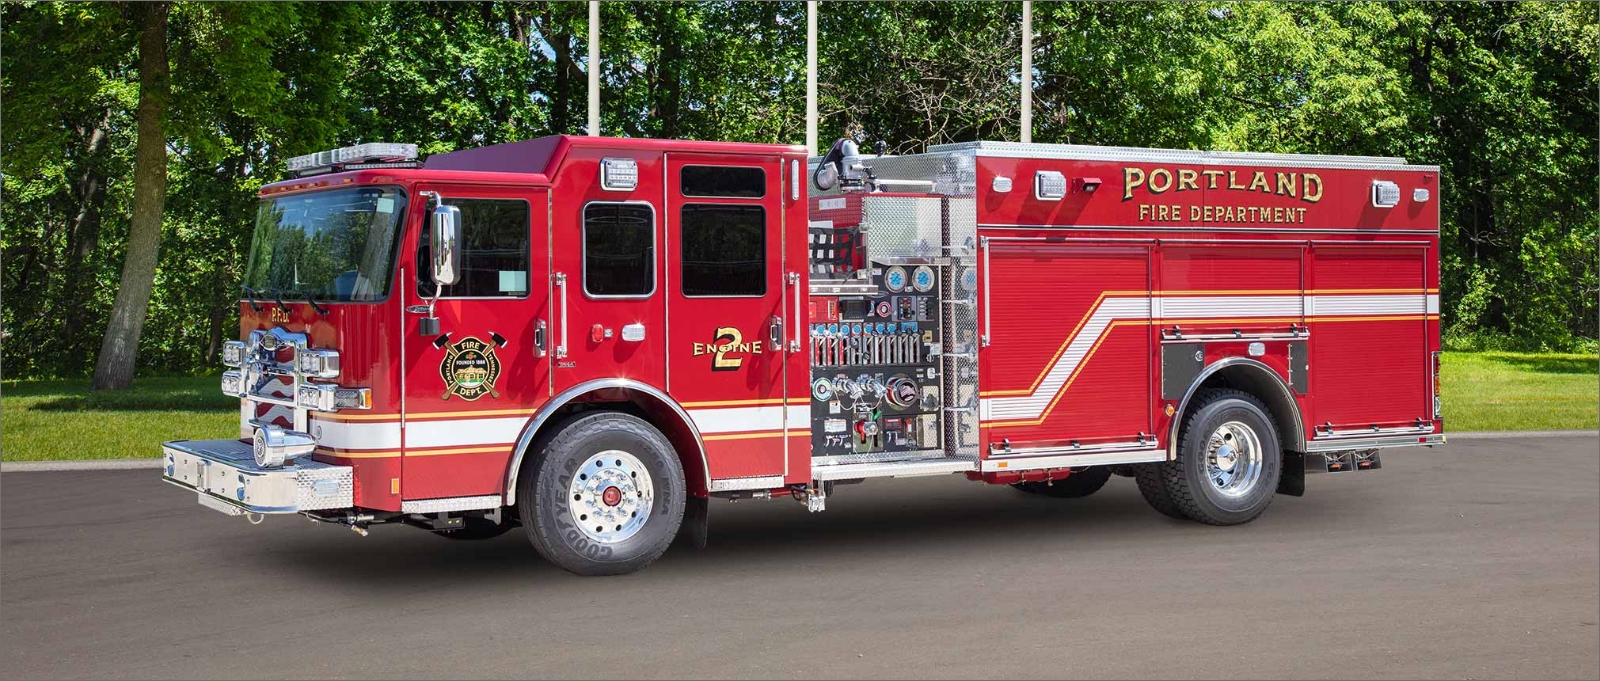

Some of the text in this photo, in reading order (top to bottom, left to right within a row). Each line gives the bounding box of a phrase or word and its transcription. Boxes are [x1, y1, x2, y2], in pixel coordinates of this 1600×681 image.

[1122, 167, 1324, 203] PORTLAND
[1139, 205, 1307, 223] FIRE DEPARTMENT
[461, 341, 480, 350] FIRE
[692, 326, 762, 372] ENGINE 2
[446, 355, 454, 384] PORTLAND
[488, 353, 496, 383] TENNESSEE
[555, 457, 613, 559] GOODYEAR
